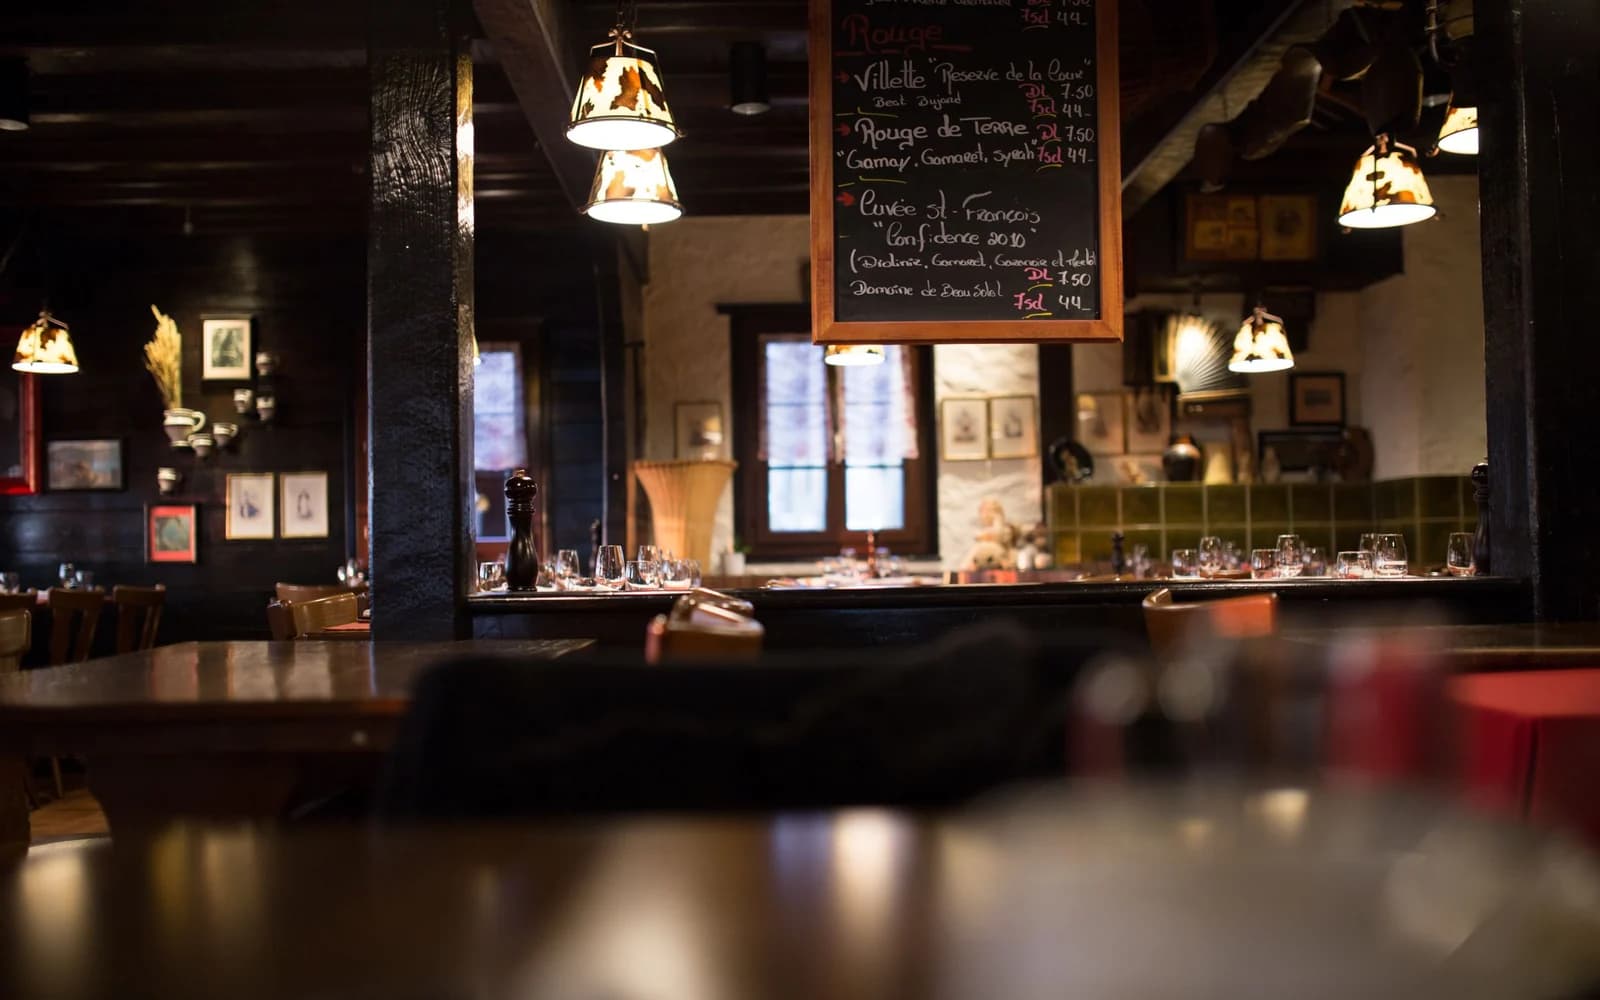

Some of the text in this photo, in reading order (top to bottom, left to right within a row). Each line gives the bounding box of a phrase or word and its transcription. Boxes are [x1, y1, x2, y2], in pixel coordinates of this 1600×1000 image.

[841, 13, 944, 58] Rouge
[854, 59, 927, 92] Villette
[1006, 61, 1025, 81] de
[1028, 60, 1042, 81] la
[872, 95, 905, 108] Beat
[1061, 83, 1094, 100] 7.50
[855, 117, 928, 150] Rouge
[937, 113, 962, 137] de
[1065, 125, 1095, 142] 7.50
[860, 188, 917, 217] Cuvée
[849, 279, 914, 297] Domaine
[920, 279, 937, 298] de
